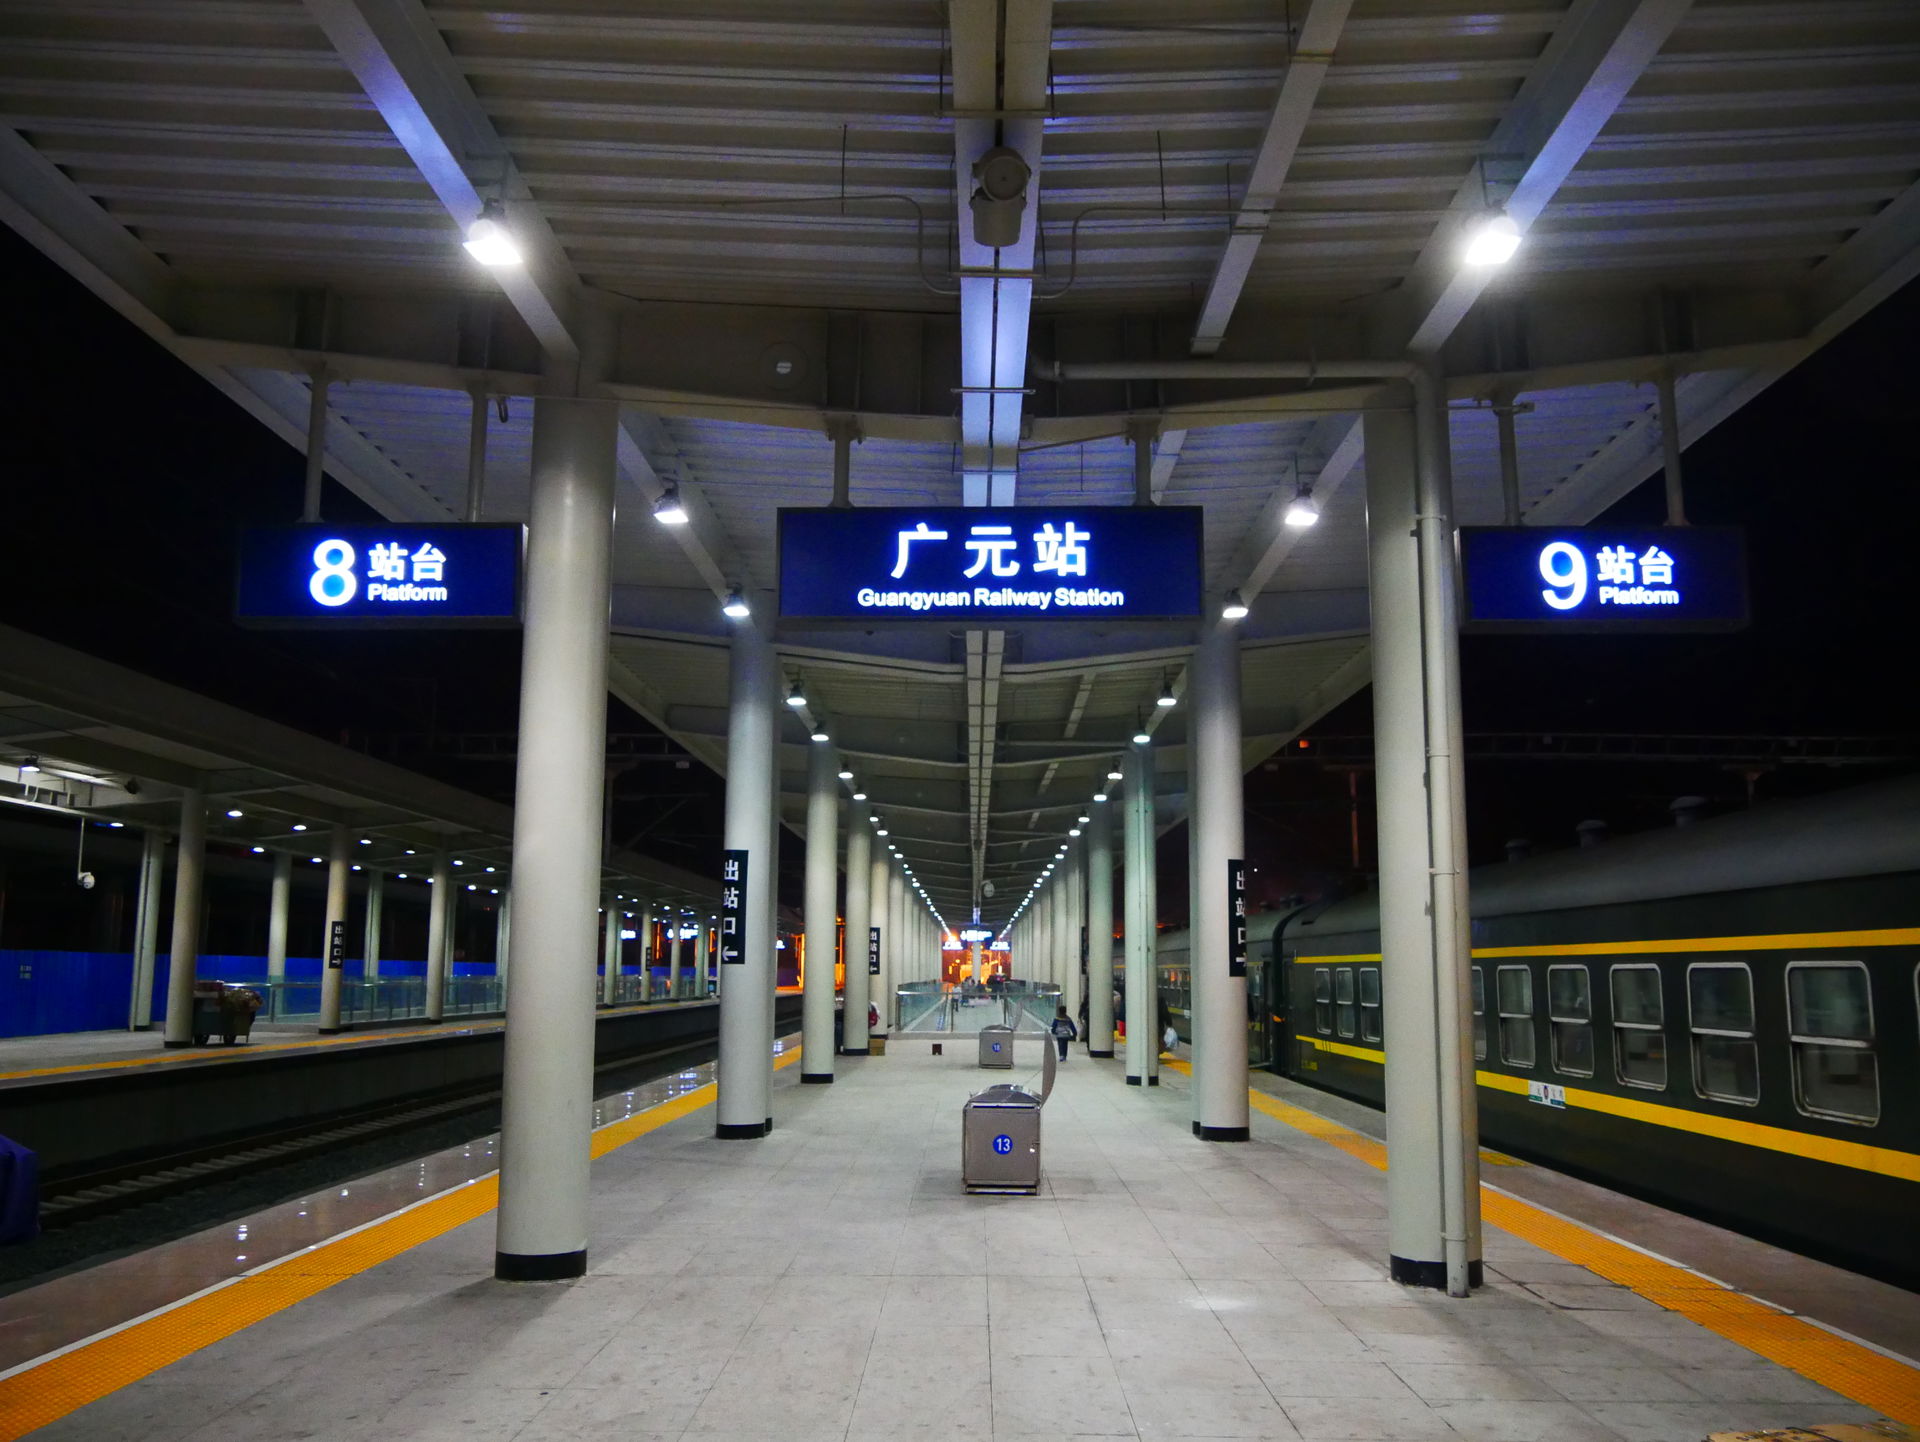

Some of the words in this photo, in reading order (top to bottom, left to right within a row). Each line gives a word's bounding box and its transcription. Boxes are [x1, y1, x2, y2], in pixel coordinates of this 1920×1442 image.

[891, 521, 1091, 579] 广元站
[309, 538, 357, 607] 8
[367, 542, 447, 582] 站台
[367, 583, 448, 602] Platform
[1539, 541, 1588, 610] 9
[1596, 545, 1675, 585] 站台
[857, 588, 970, 611] Guangyuan
[974, 588, 1052, 611] Railway
[1054, 588, 1124, 607] Station
[1599, 586, 1680, 605] Platform
[723, 859, 739, 935] 出站口
[996, 1137, 1011, 1152] 13
